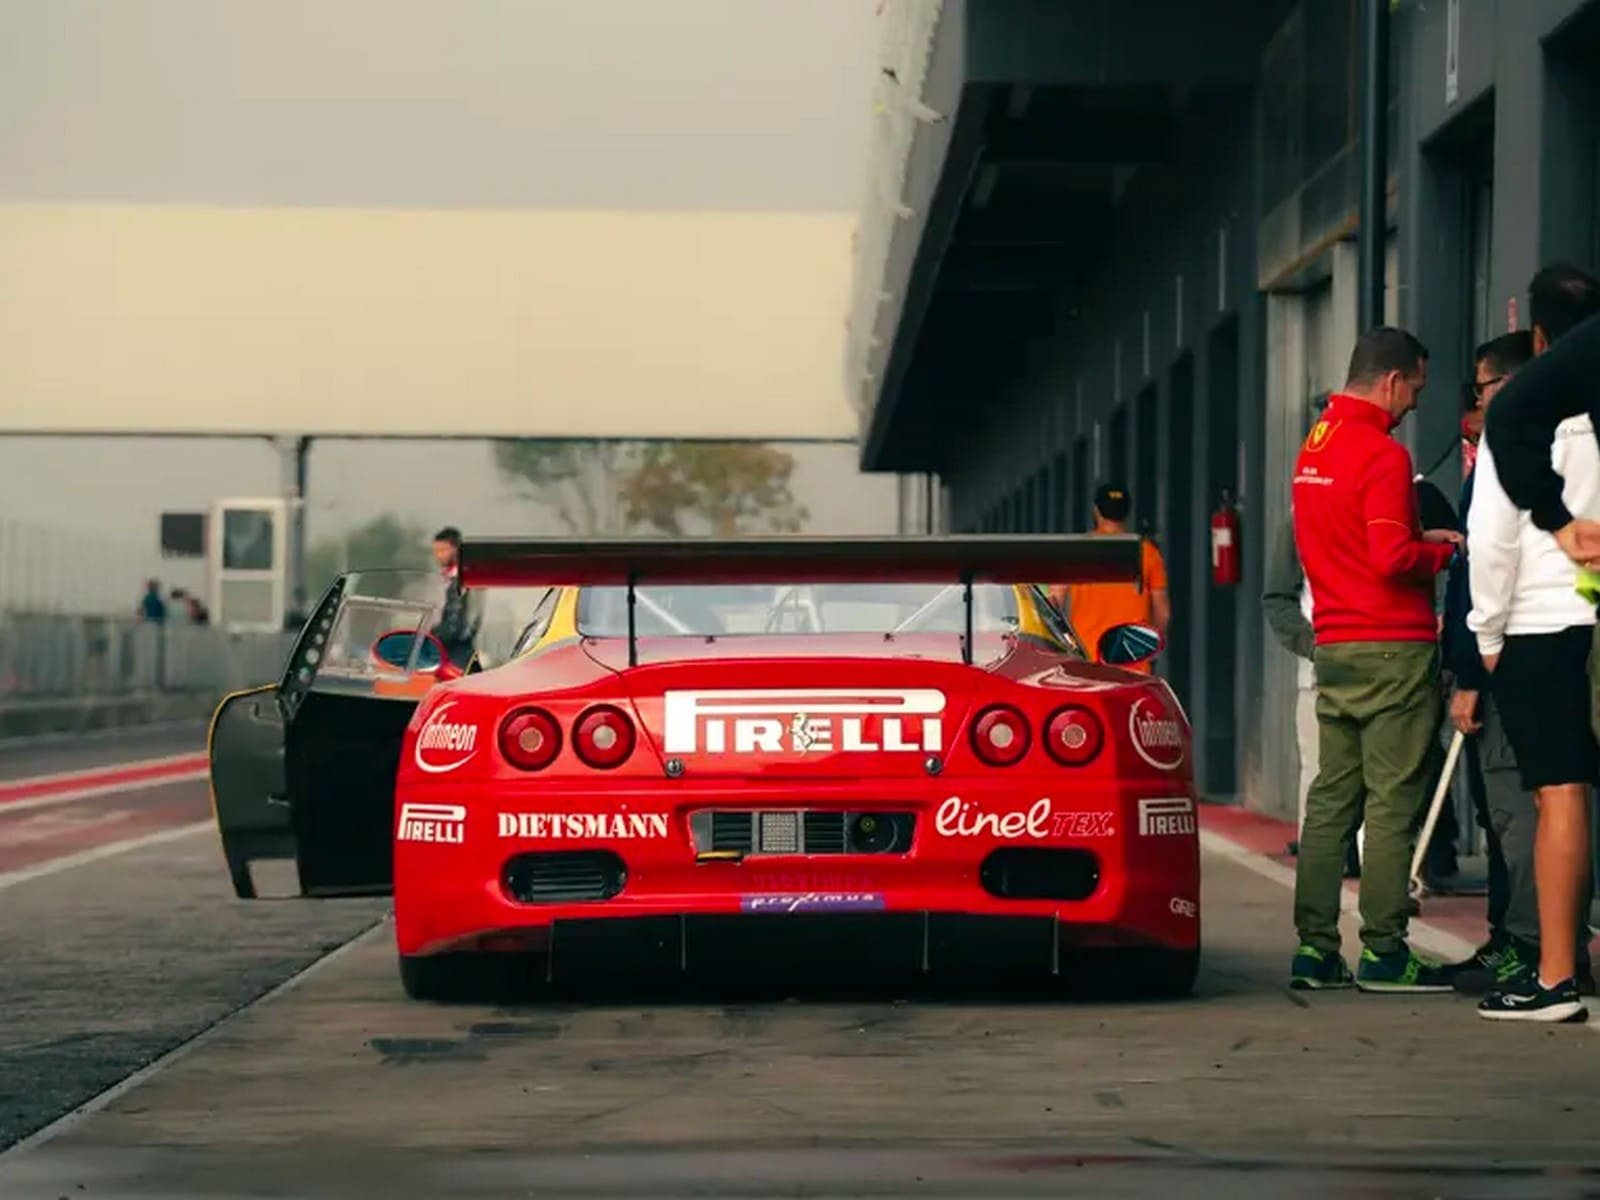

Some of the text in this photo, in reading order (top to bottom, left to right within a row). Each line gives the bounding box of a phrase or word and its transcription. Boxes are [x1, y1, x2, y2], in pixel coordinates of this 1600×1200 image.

[664, 688, 946, 753] PIRELLI
[398, 803, 466, 843] PIRELLI
[497, 811, 669, 839] DIETSMANN
[935, 796, 1051, 838] linel
